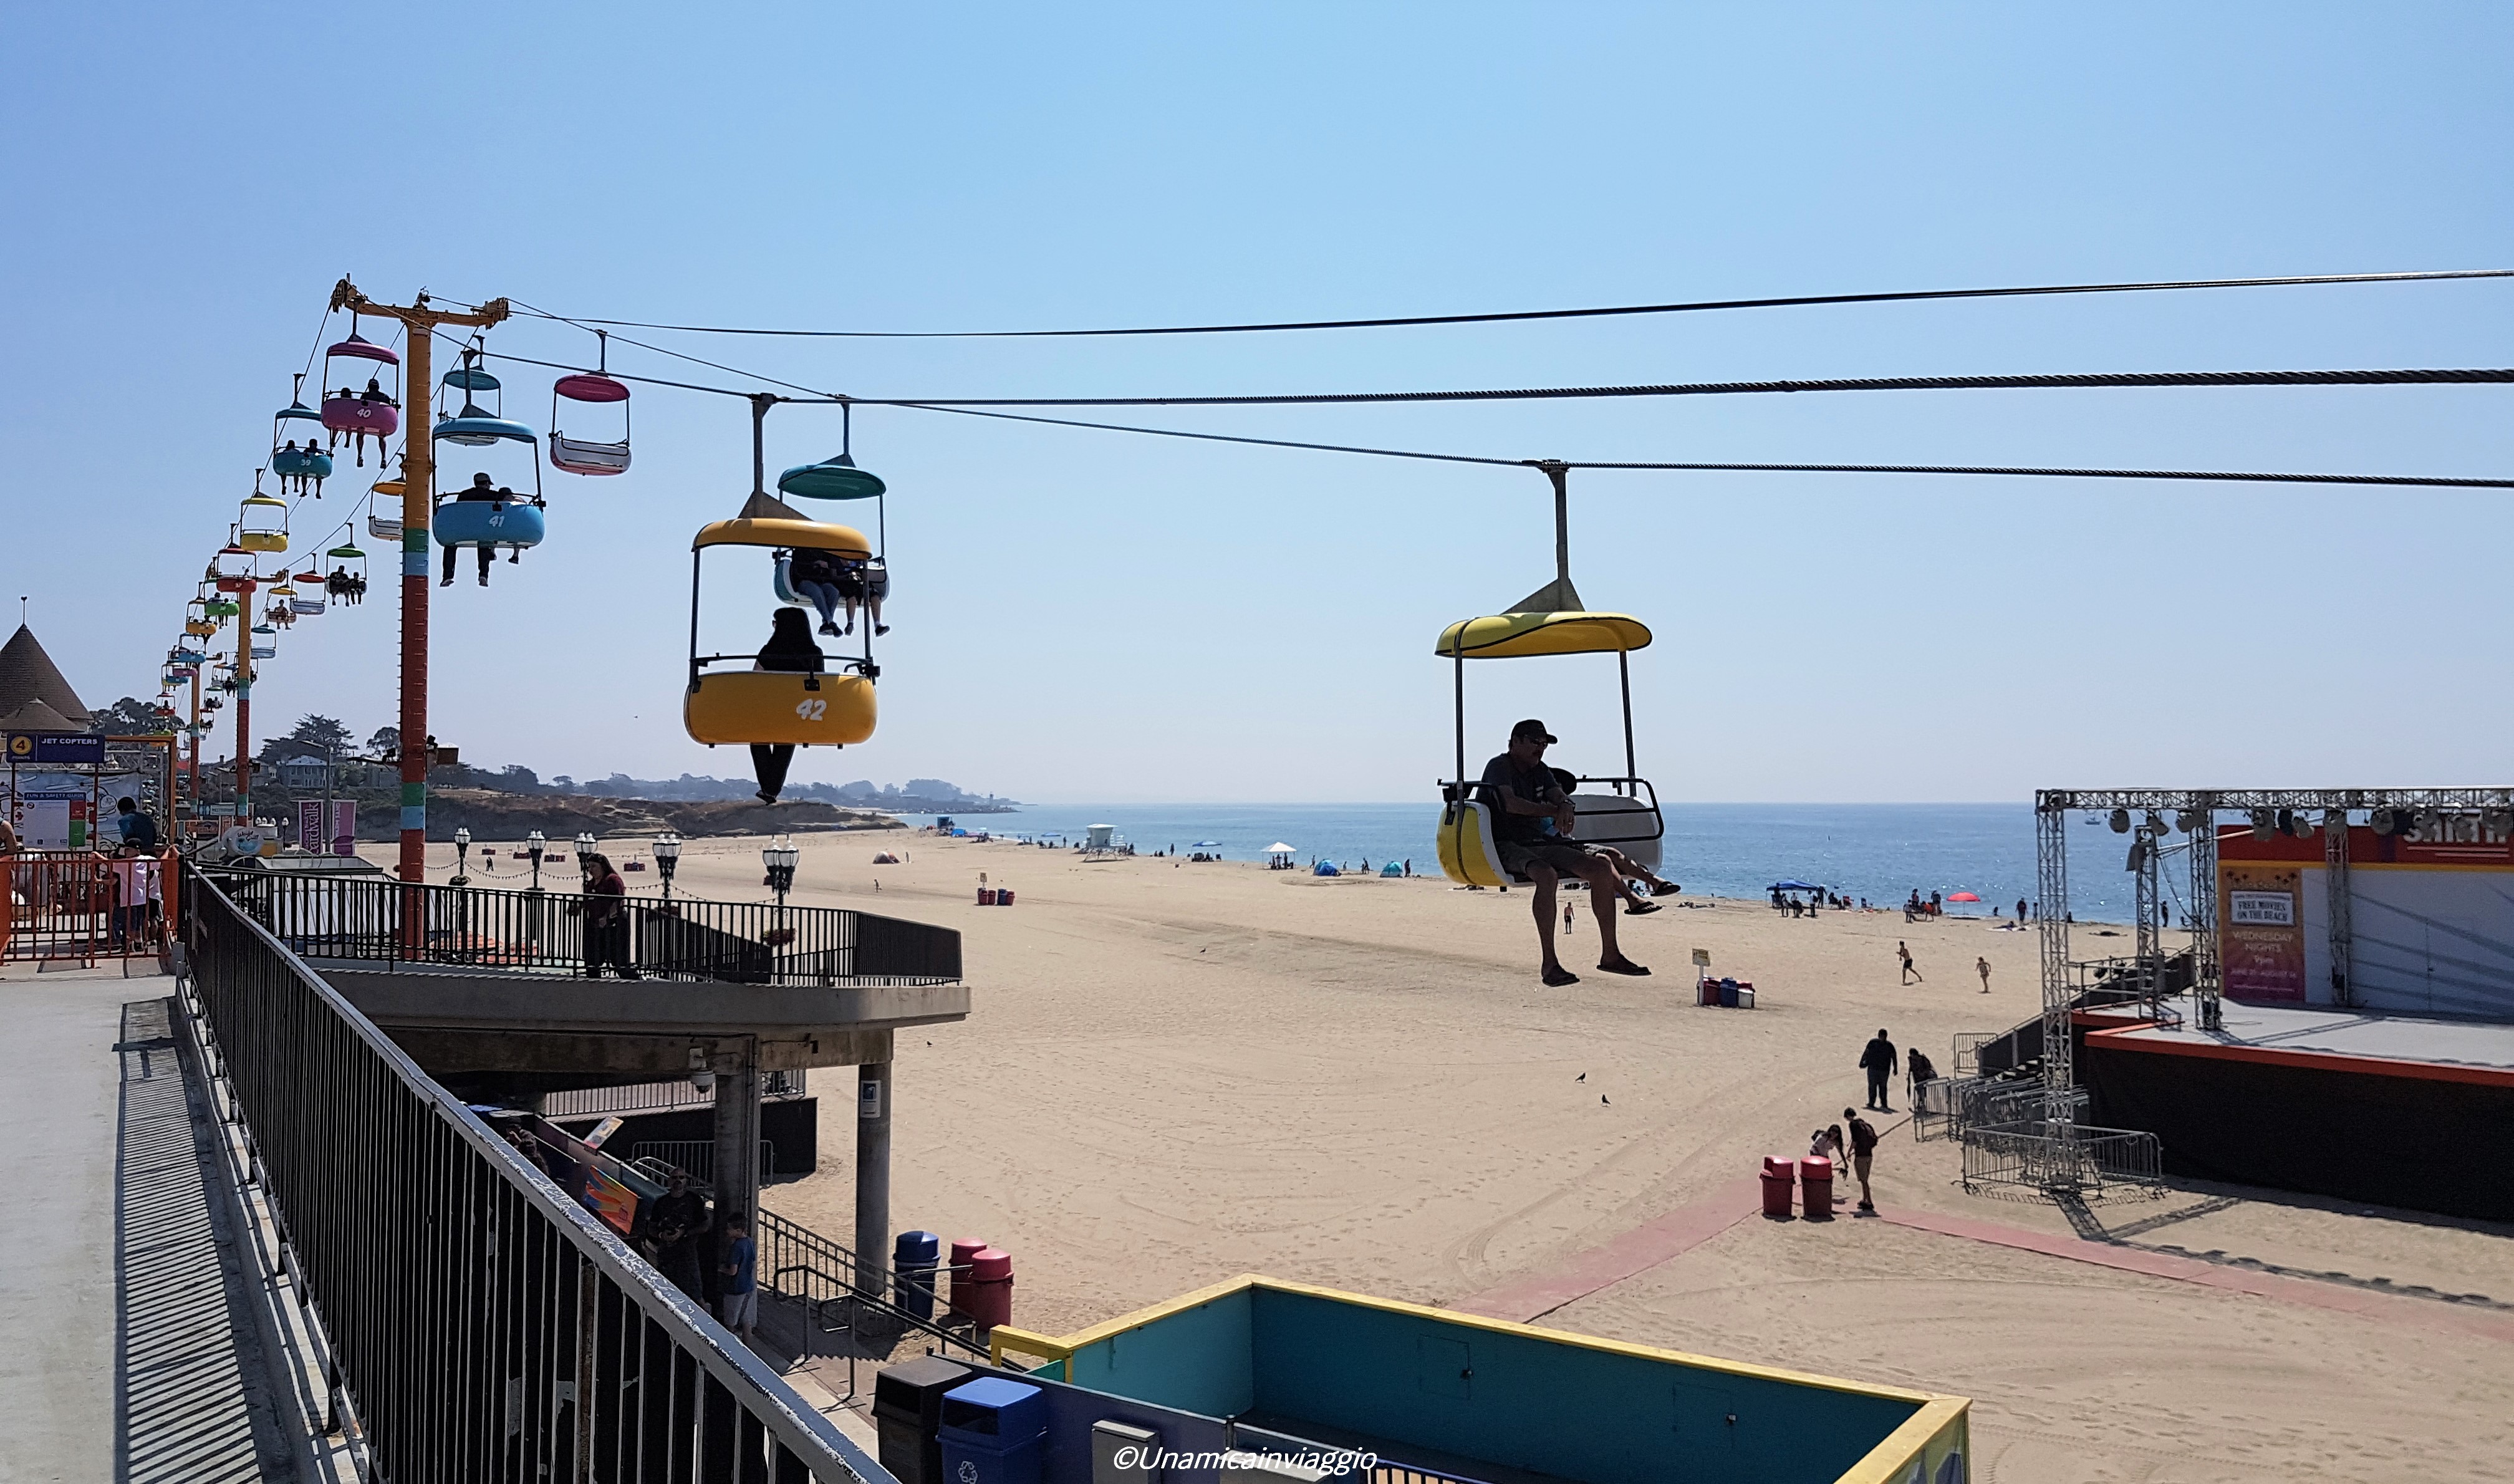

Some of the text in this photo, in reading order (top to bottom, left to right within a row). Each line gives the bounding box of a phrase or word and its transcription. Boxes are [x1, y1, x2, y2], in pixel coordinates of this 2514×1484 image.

[357, 408, 372, 418] 40
[489, 515, 505, 528] 41
[796, 698, 827, 721] 42
[16, 740, 25, 750] 4
[304, 803, 319, 854] oardwalk
[2237, 900, 2286, 911] FREE MOVIES
[2263, 910, 2288, 922] BEACH
[2232, 931, 2293, 942] WEDNESDAY
